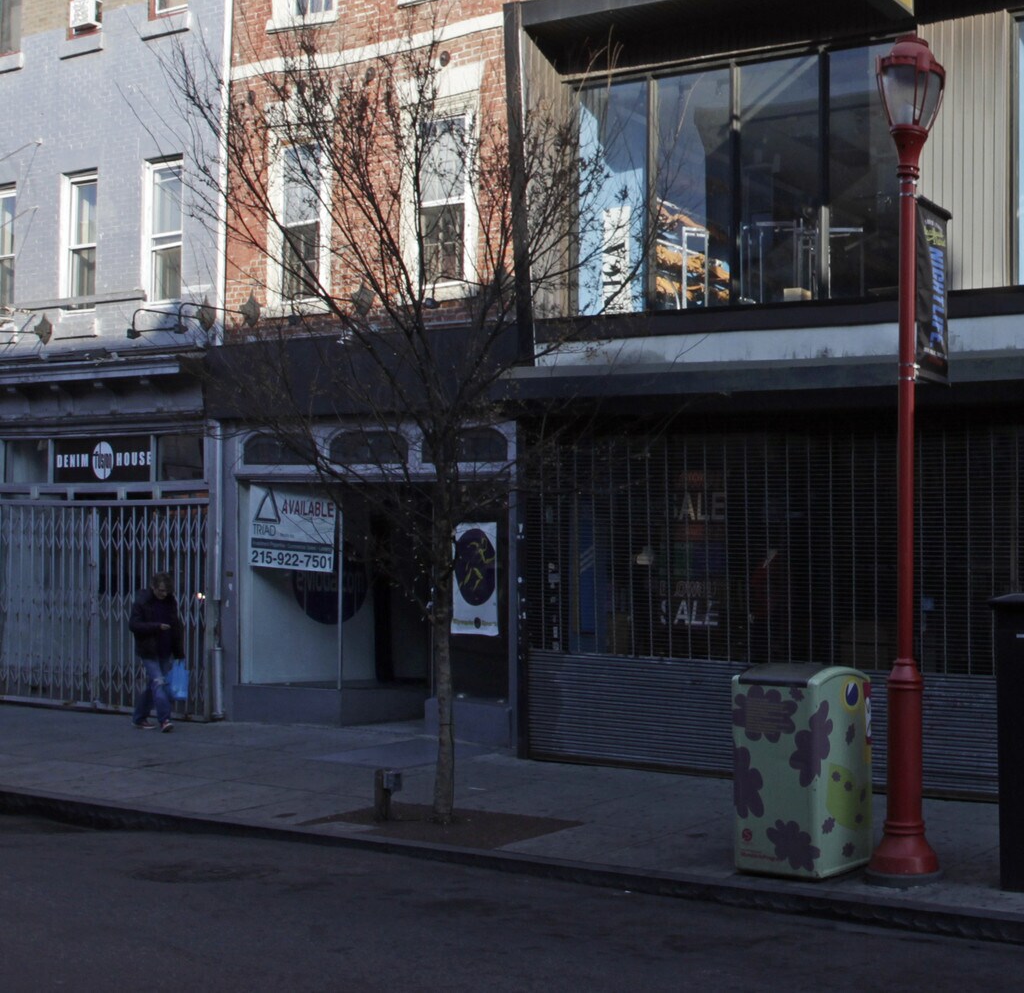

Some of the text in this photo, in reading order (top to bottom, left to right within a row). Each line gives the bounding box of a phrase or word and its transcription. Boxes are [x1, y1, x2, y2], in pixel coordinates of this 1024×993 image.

[929, 246, 945, 348] NIGHTLIFE
[56, 453, 89, 468] DENIM
[115, 451, 151, 467] HOUSE
[281, 499, 334, 518] AVAILABLE
[252, 523, 277, 537] TRIAD
[251, 550, 333, 569] 215-922-7501
